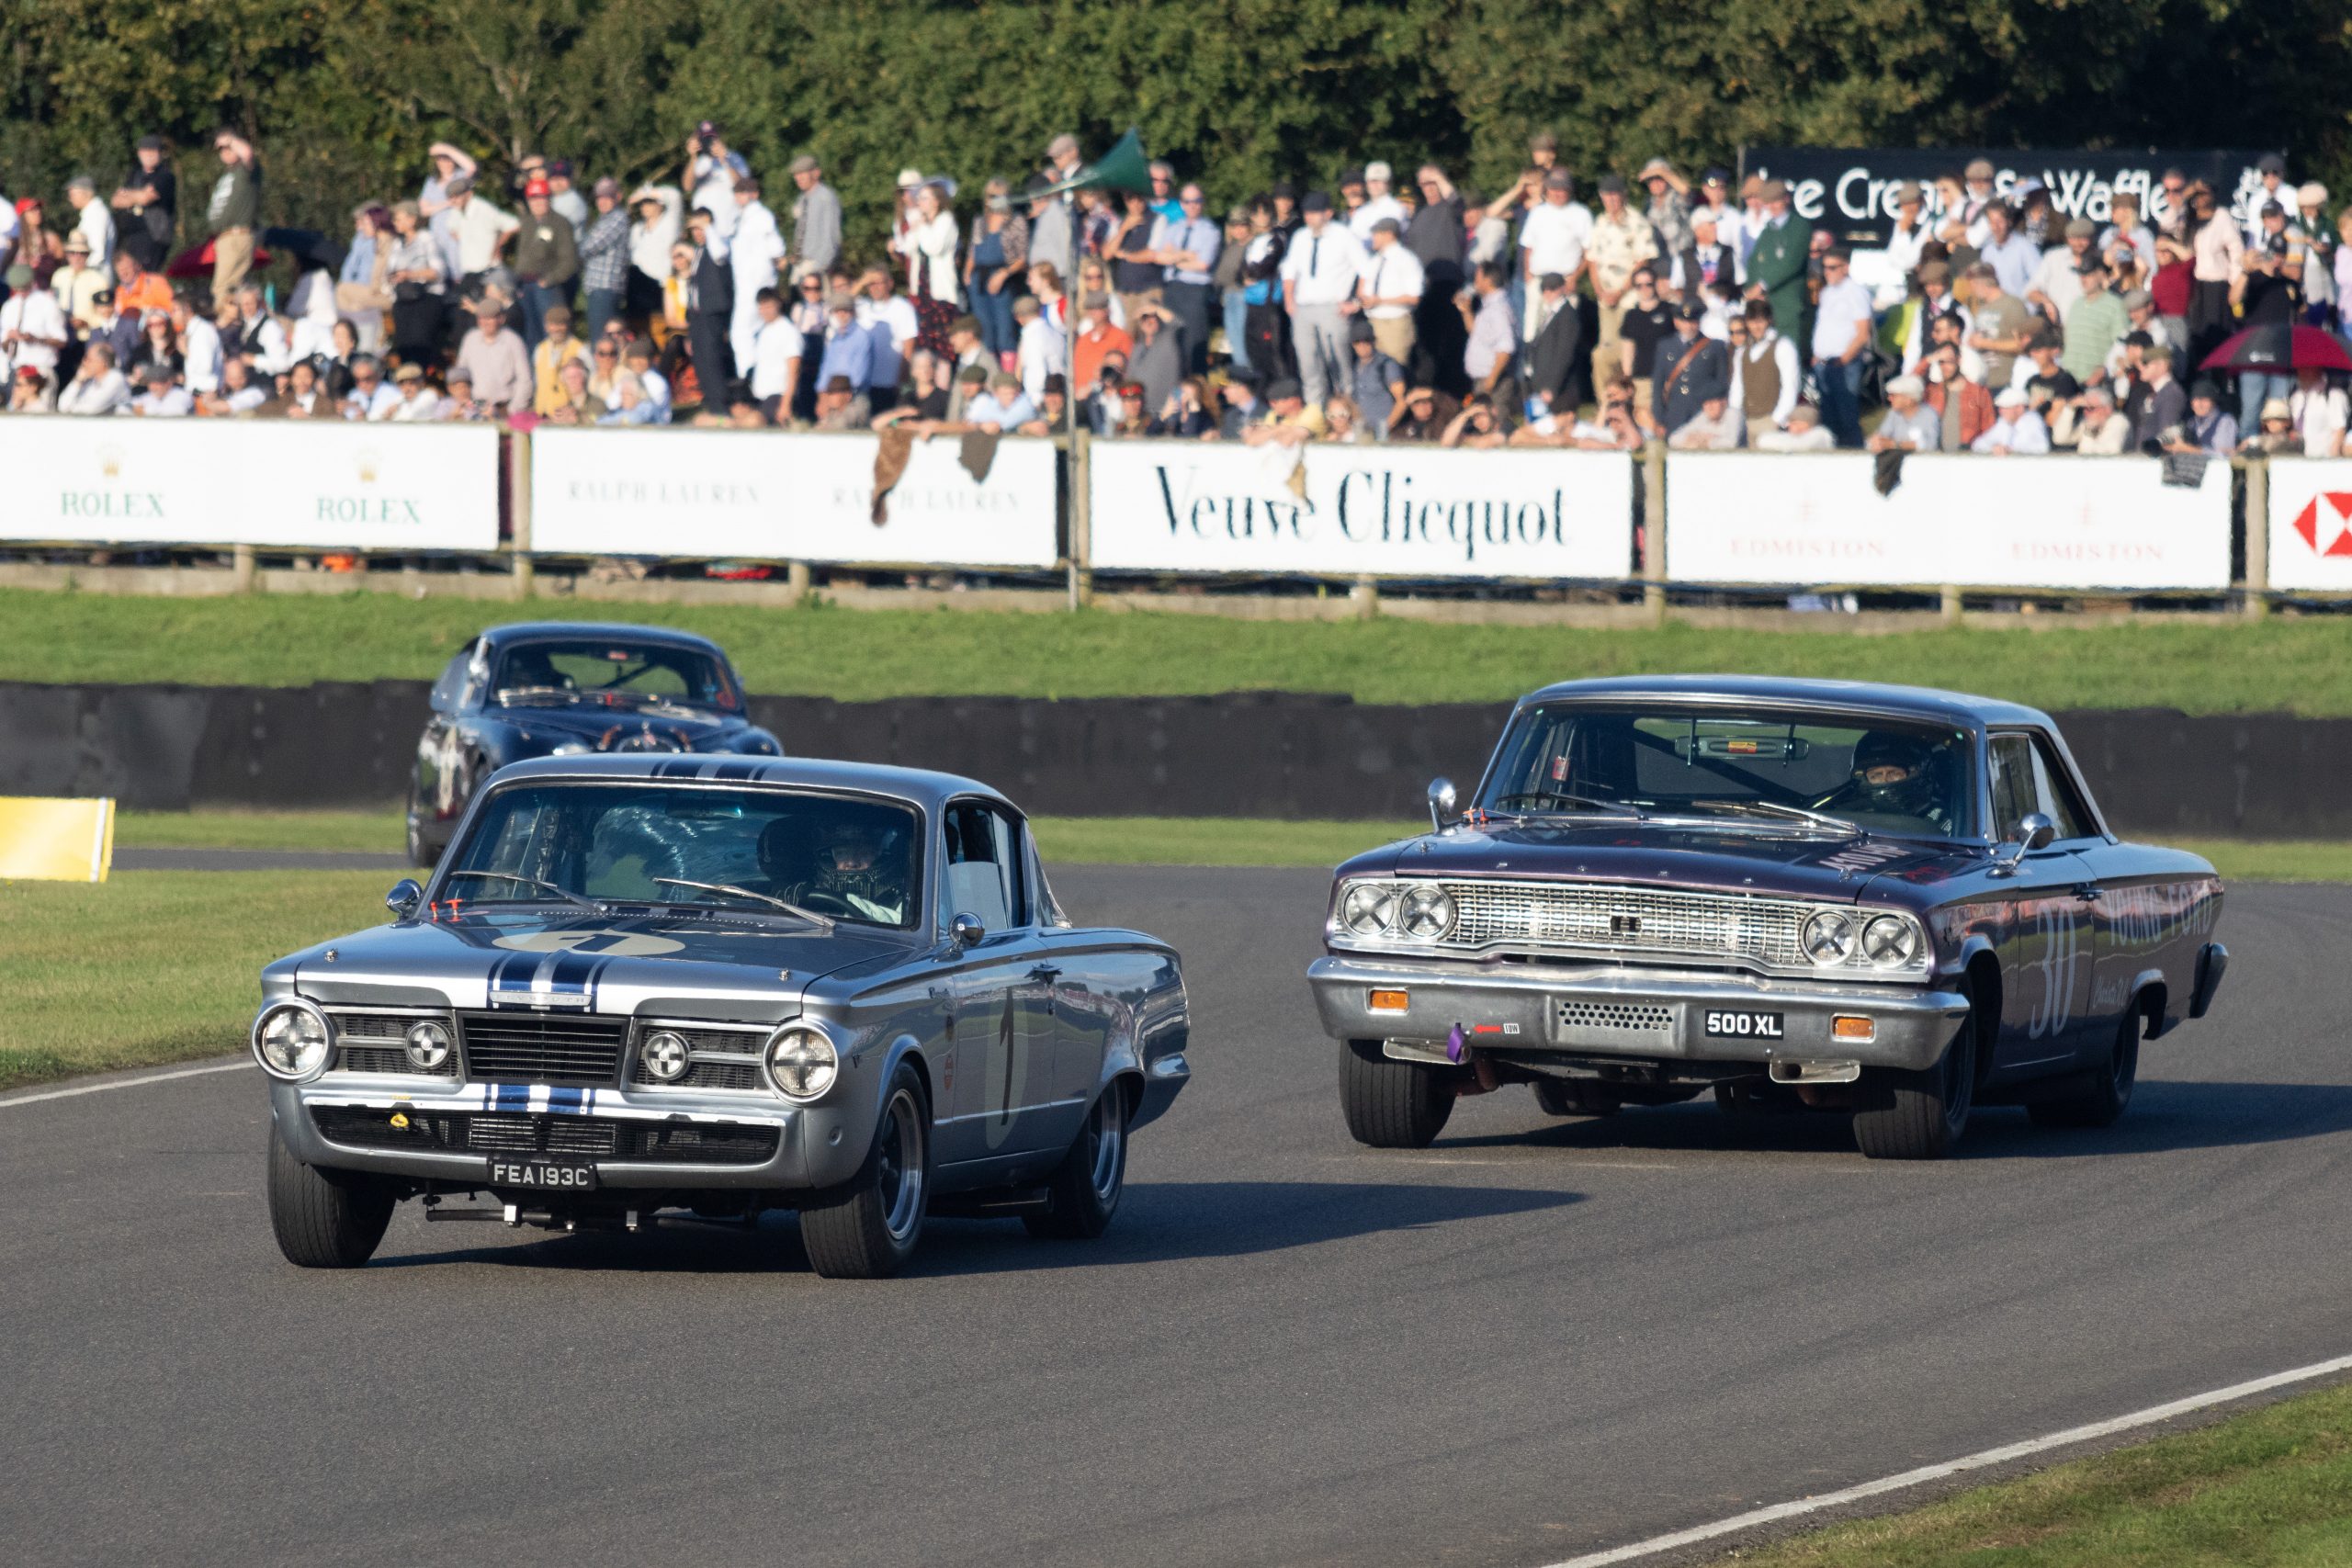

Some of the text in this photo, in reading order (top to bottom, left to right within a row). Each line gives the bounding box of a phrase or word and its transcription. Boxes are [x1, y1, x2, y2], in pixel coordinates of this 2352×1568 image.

[61, 491, 164, 517] ROLEX
[568, 480, 760, 504] RALPH LAUREN
[831, 487, 1019, 512] RAH LAUREN
[316, 497, 421, 524] ROLEX
[1154, 466, 1568, 560] Veuve Clicquot
[1730, 538, 1885, 558] EDMISTON
[2011, 542, 2163, 561] EDMISTON
[2106, 883, 2213, 947] YOUNG FORD
[559, 933, 630, 953] 1
[2029, 900, 2076, 1040] 30
[1707, 1012, 1782, 1036] 500 XL
[1000, 987, 1014, 1125] 1
